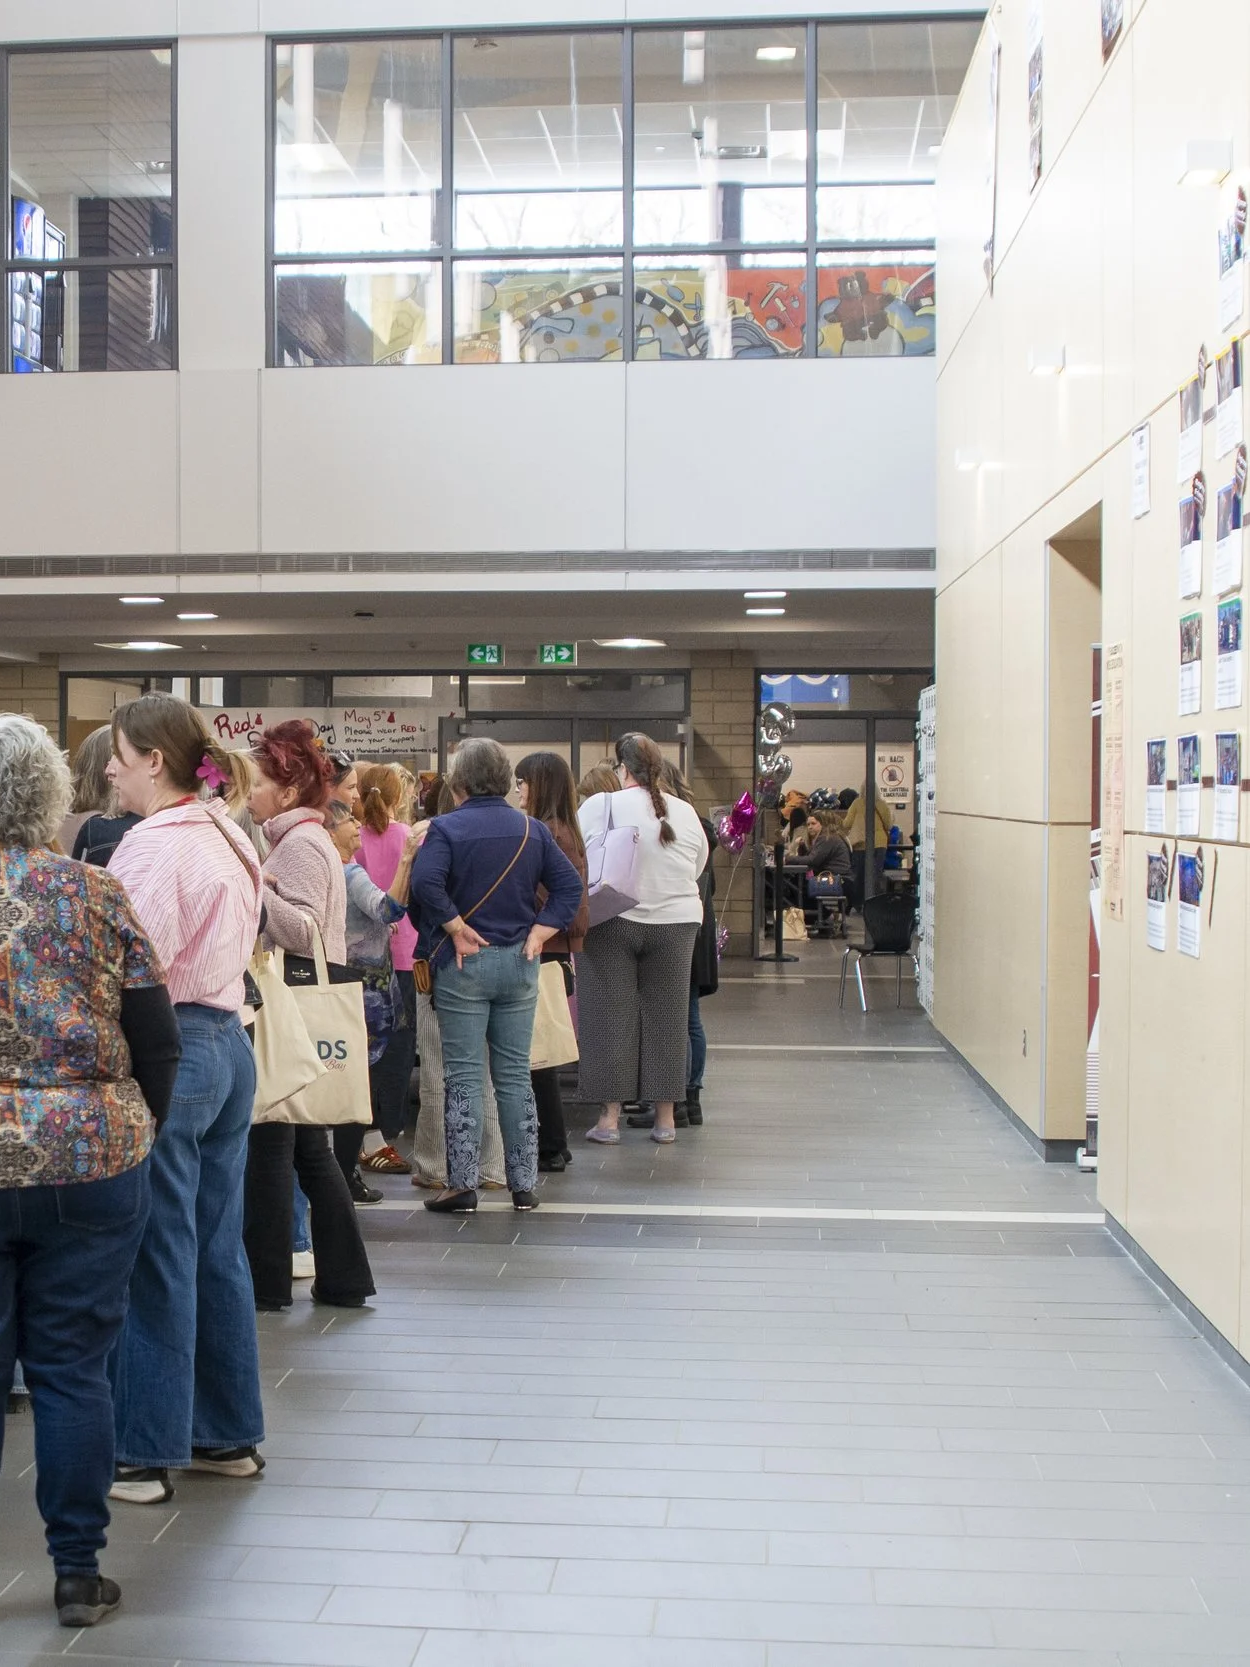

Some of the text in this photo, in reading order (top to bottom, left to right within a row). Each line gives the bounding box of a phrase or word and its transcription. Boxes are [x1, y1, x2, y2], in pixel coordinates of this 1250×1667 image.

[214, 711, 255, 739] Red
[344, 709, 371, 729] May
[344, 726, 372, 735] Please
[401, 724, 416, 733] RED
[419, 724, 426, 732] to
[317, 1040, 348, 1060] DS
[324, 1058, 347, 1071] Bay
